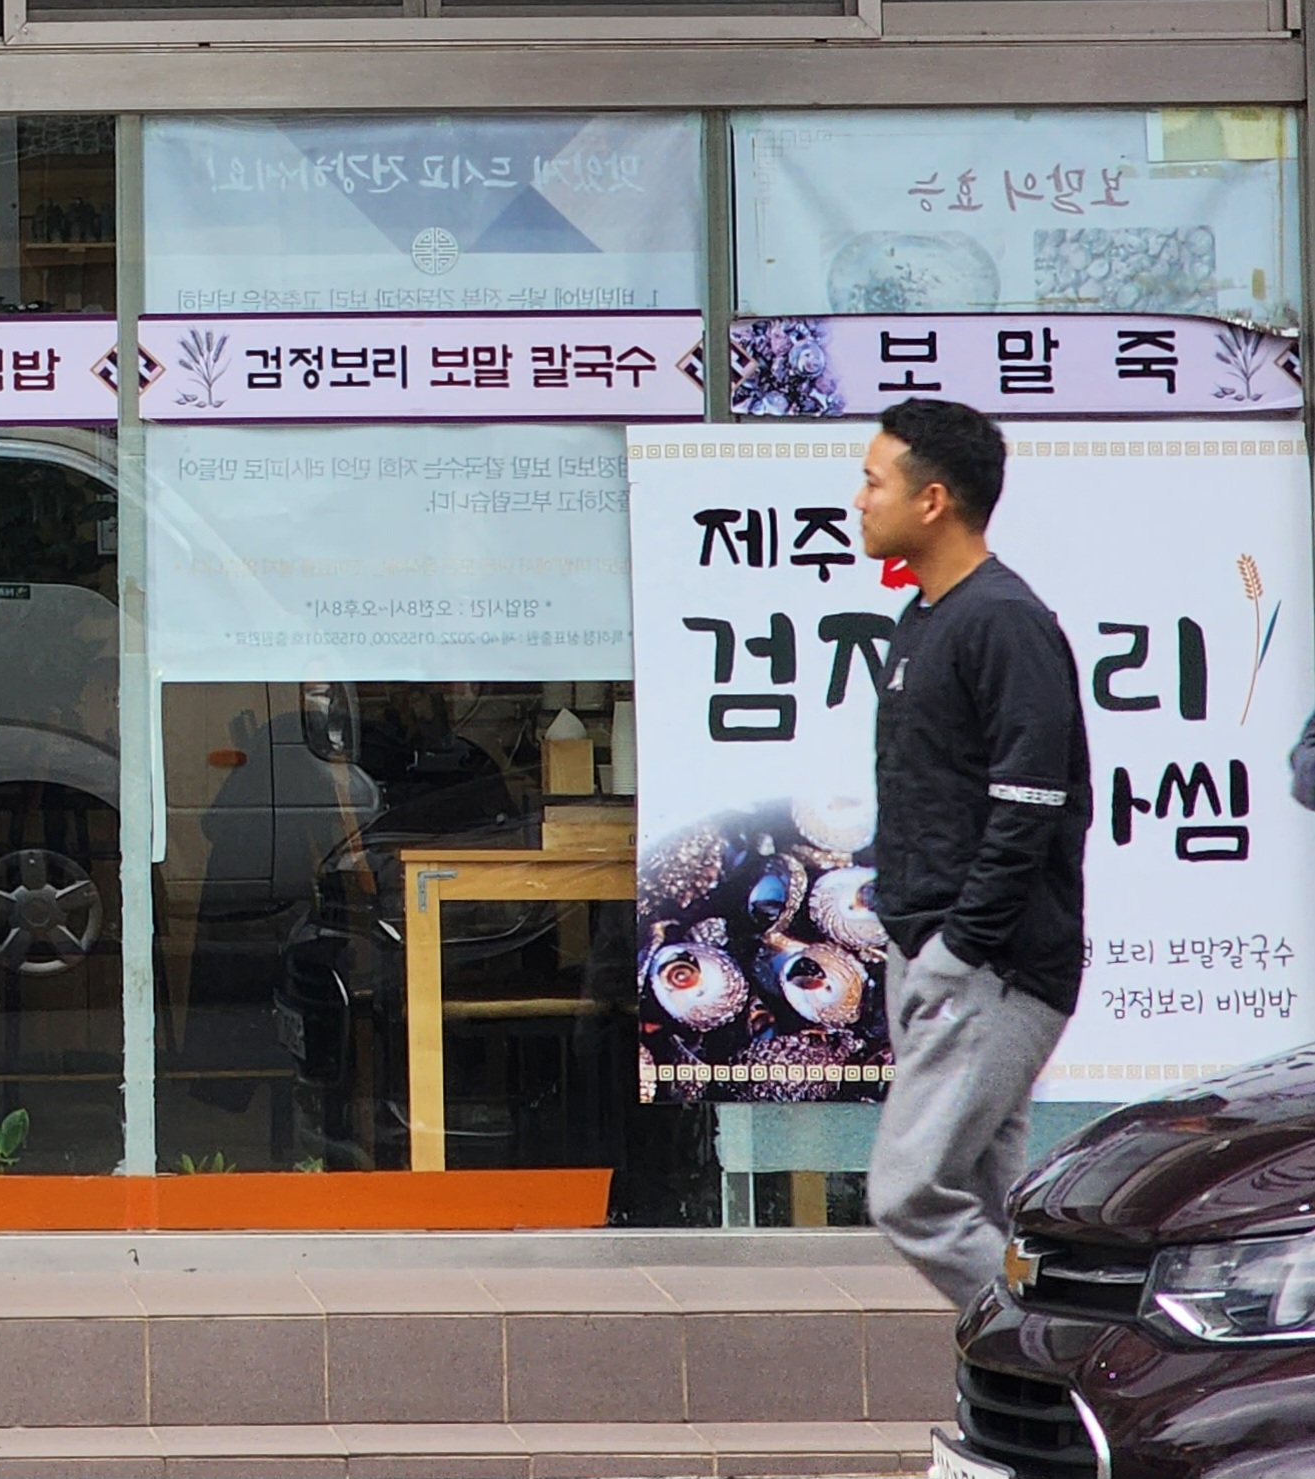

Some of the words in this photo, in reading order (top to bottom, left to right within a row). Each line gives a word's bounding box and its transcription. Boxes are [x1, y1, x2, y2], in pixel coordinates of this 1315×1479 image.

[245, 344, 408, 390] 검정보리
[430, 343, 512, 389] 보말
[531, 343, 657, 389] 칼국수
[693, 507, 855, 582] 제주
[1106, 937, 1155, 966] 보리
[1167, 932, 1296, 969] 보말칼국수
[1102, 986, 1204, 1020] 검정보리
[1217, 987, 1297, 1018] 비빔밥
